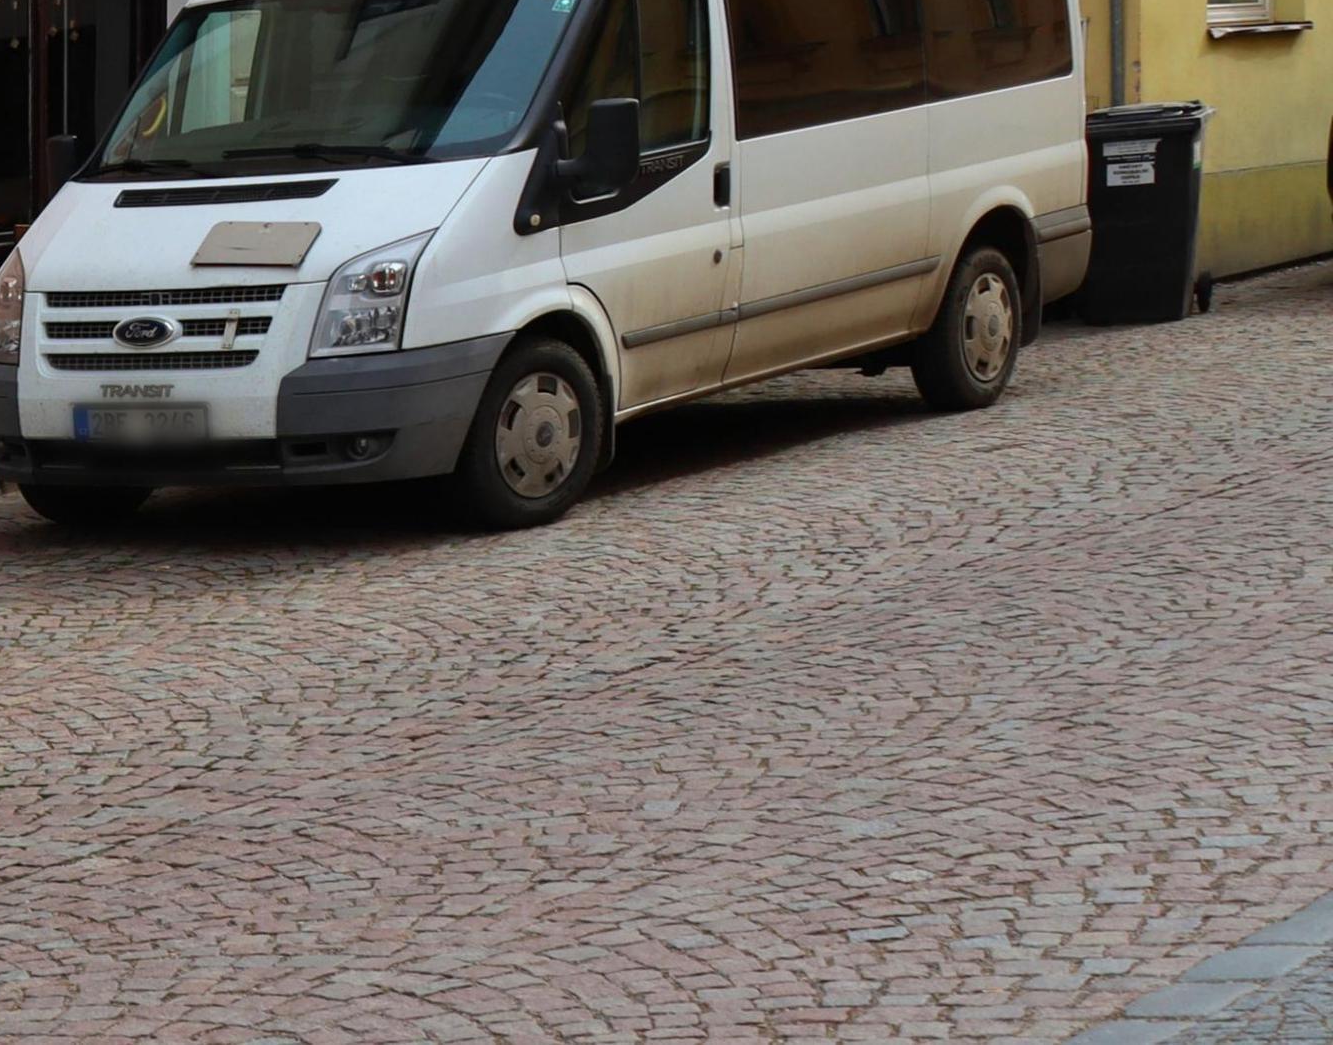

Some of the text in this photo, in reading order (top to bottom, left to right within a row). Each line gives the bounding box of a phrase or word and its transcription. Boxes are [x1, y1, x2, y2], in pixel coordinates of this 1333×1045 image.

[639, 155, 684, 174] TRANSIT
[125, 322, 158, 338] Ford
[100, 384, 174, 398] TRANSIT
